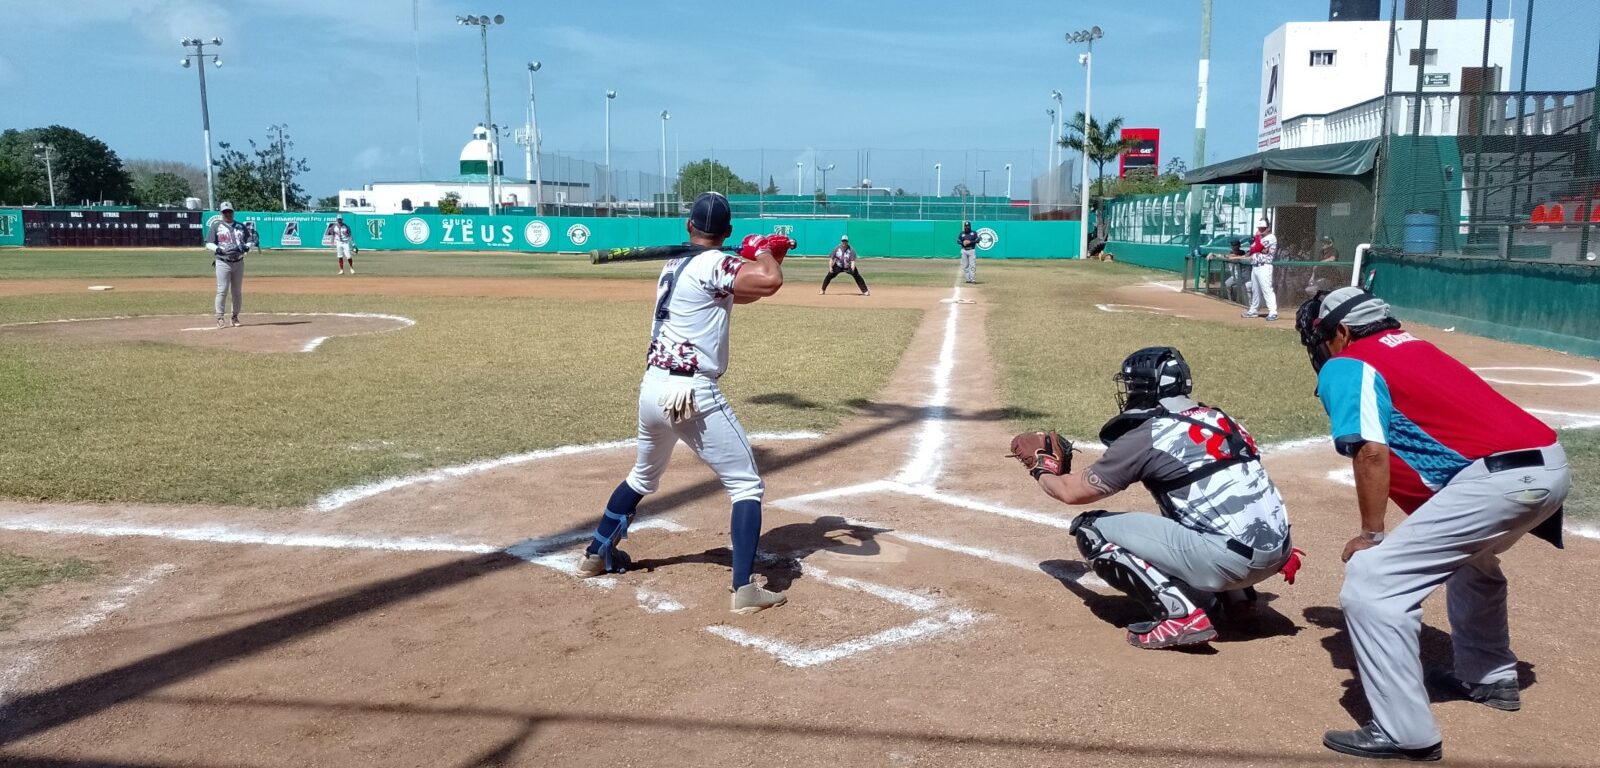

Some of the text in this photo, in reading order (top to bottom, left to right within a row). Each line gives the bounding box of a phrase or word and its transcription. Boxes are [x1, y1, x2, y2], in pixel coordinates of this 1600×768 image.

[442, 218, 474, 226] GRUPO
[442, 224, 514, 243] ZEUS
[655, 271, 674, 321] 2
